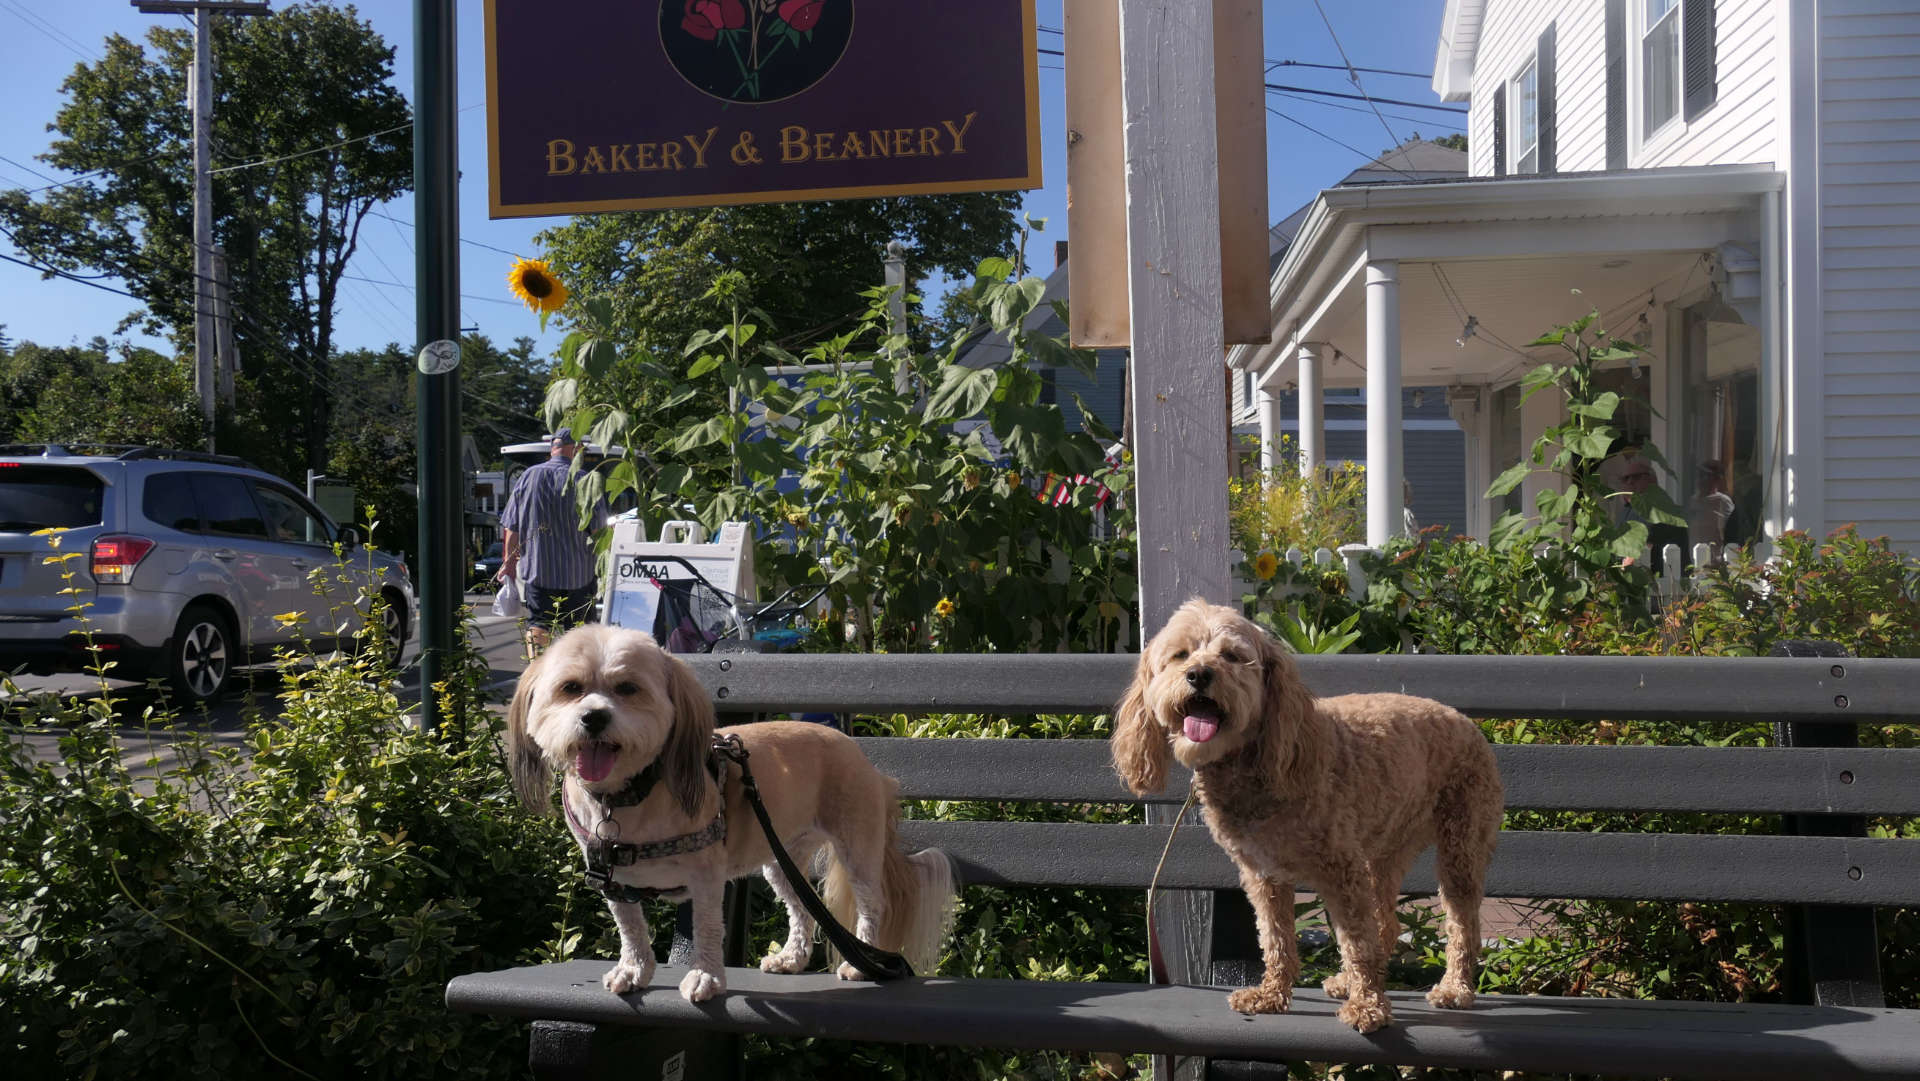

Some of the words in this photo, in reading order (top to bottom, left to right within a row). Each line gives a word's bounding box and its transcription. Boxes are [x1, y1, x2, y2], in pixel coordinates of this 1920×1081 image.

[546, 128, 718, 176] BAKERY
[731, 131, 763, 166] &
[780, 112, 977, 163] BEANERY
[620, 563, 669, 578] OMAA
